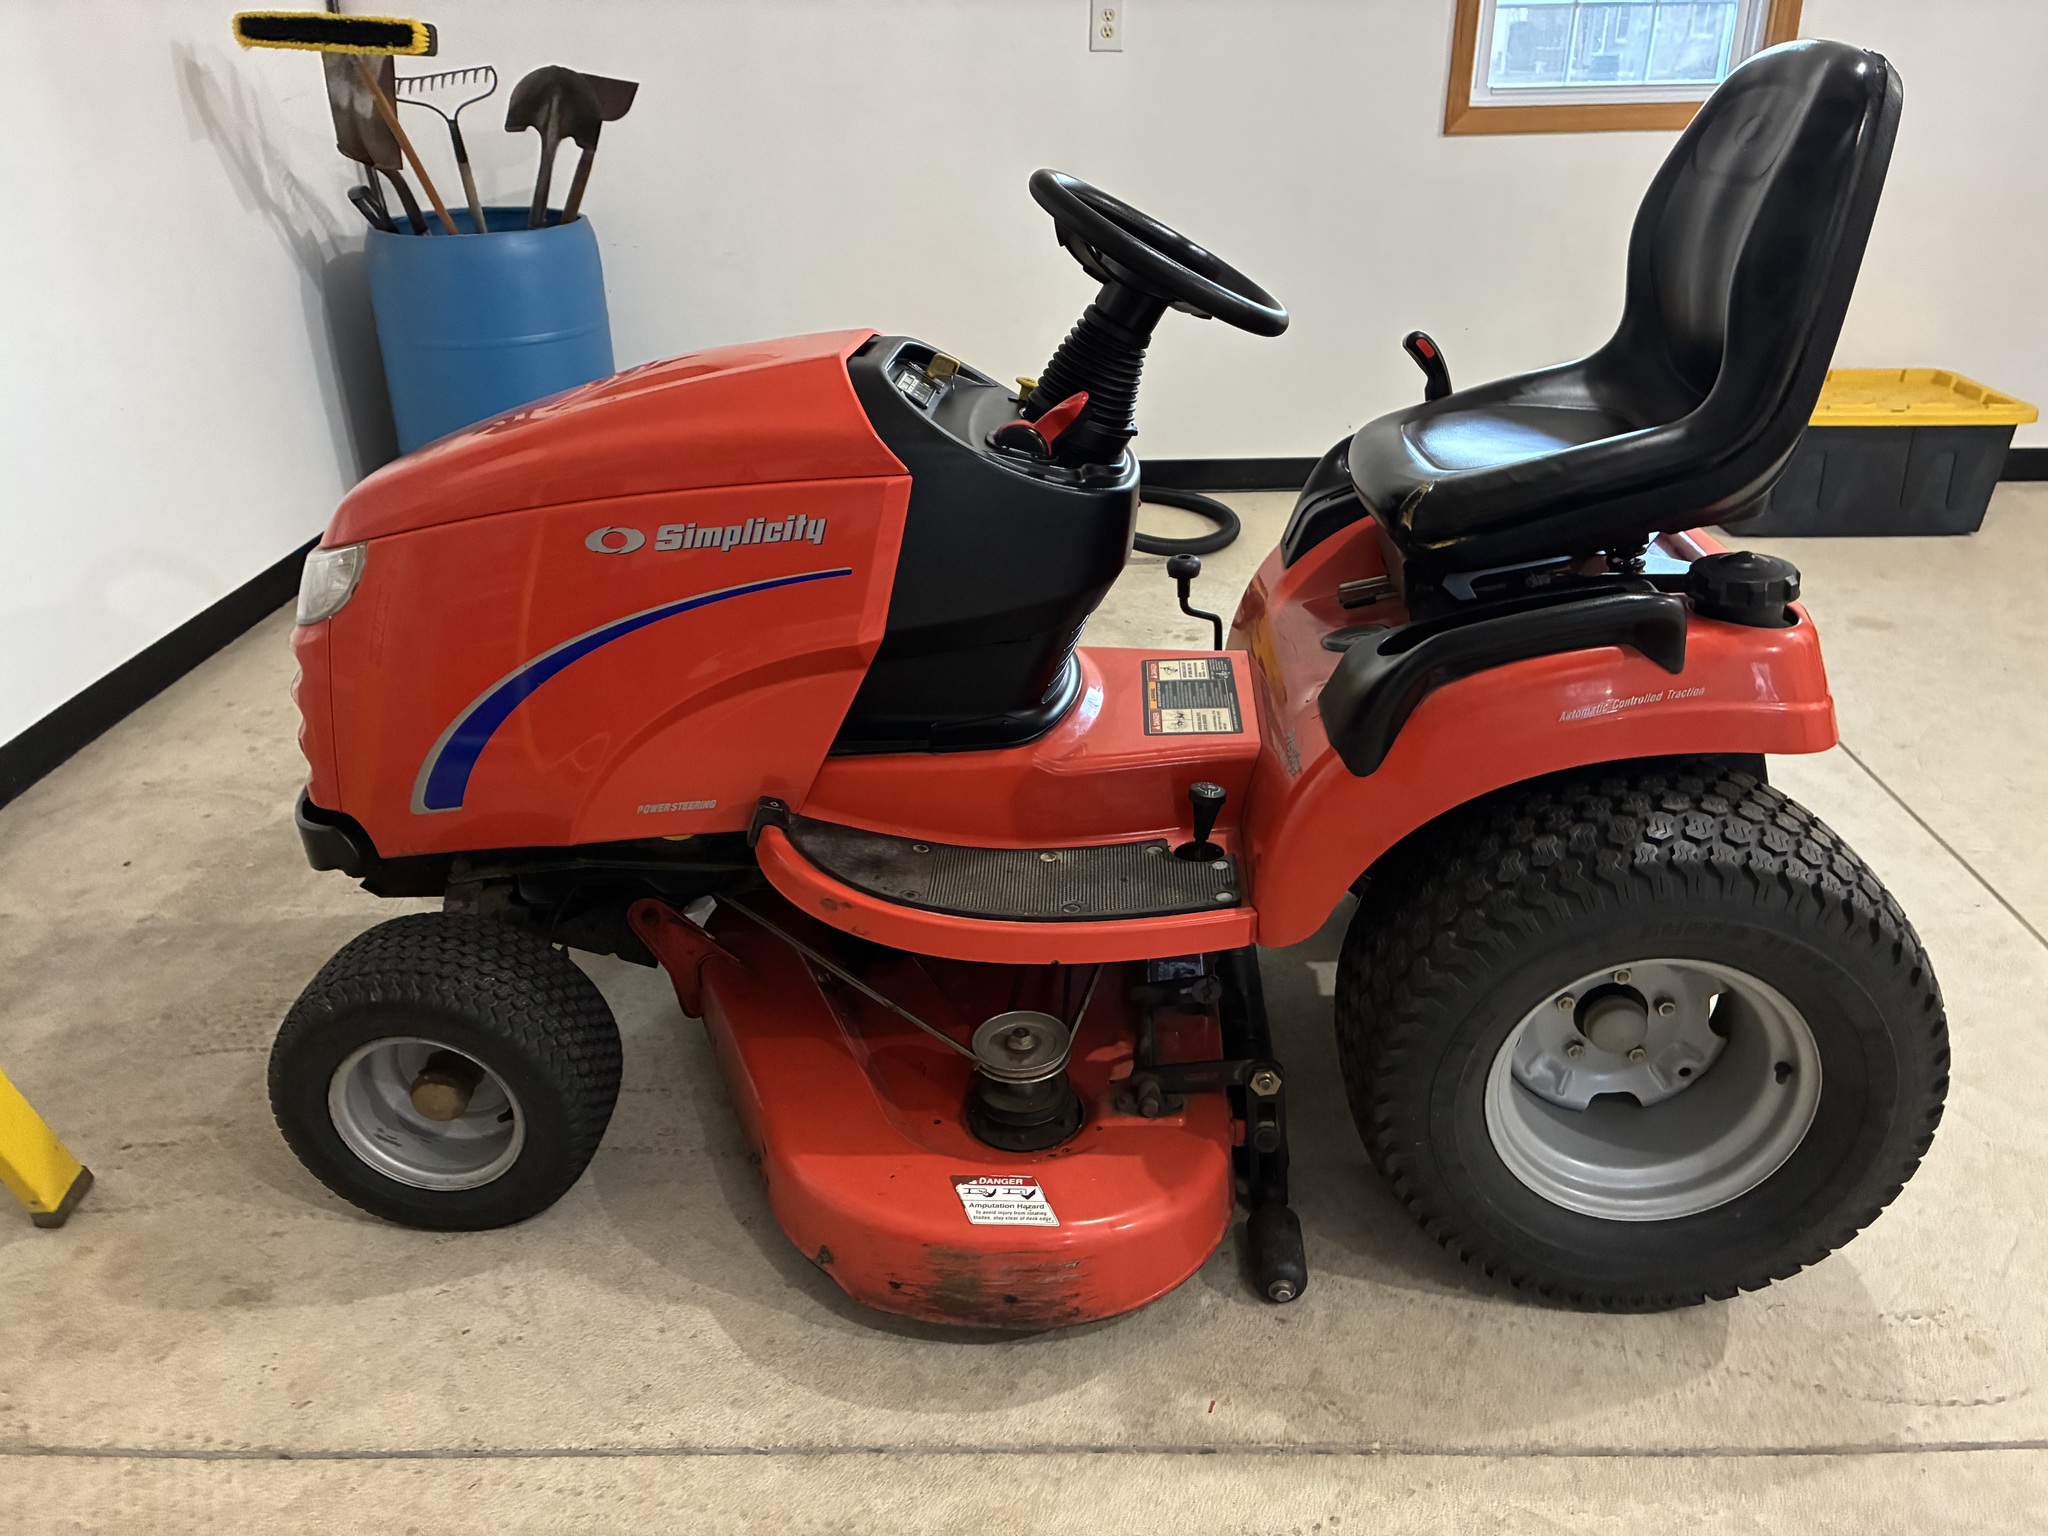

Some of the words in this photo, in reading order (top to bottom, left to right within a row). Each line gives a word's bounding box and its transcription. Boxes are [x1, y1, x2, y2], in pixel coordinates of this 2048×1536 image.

[654, 514, 827, 551] Simplicity
[1559, 704, 1608, 722] Automatic
[1612, 691, 1663, 709] Controlled
[1667, 687, 1706, 700] Traction
[979, 1177, 1023, 1185] DANGER
